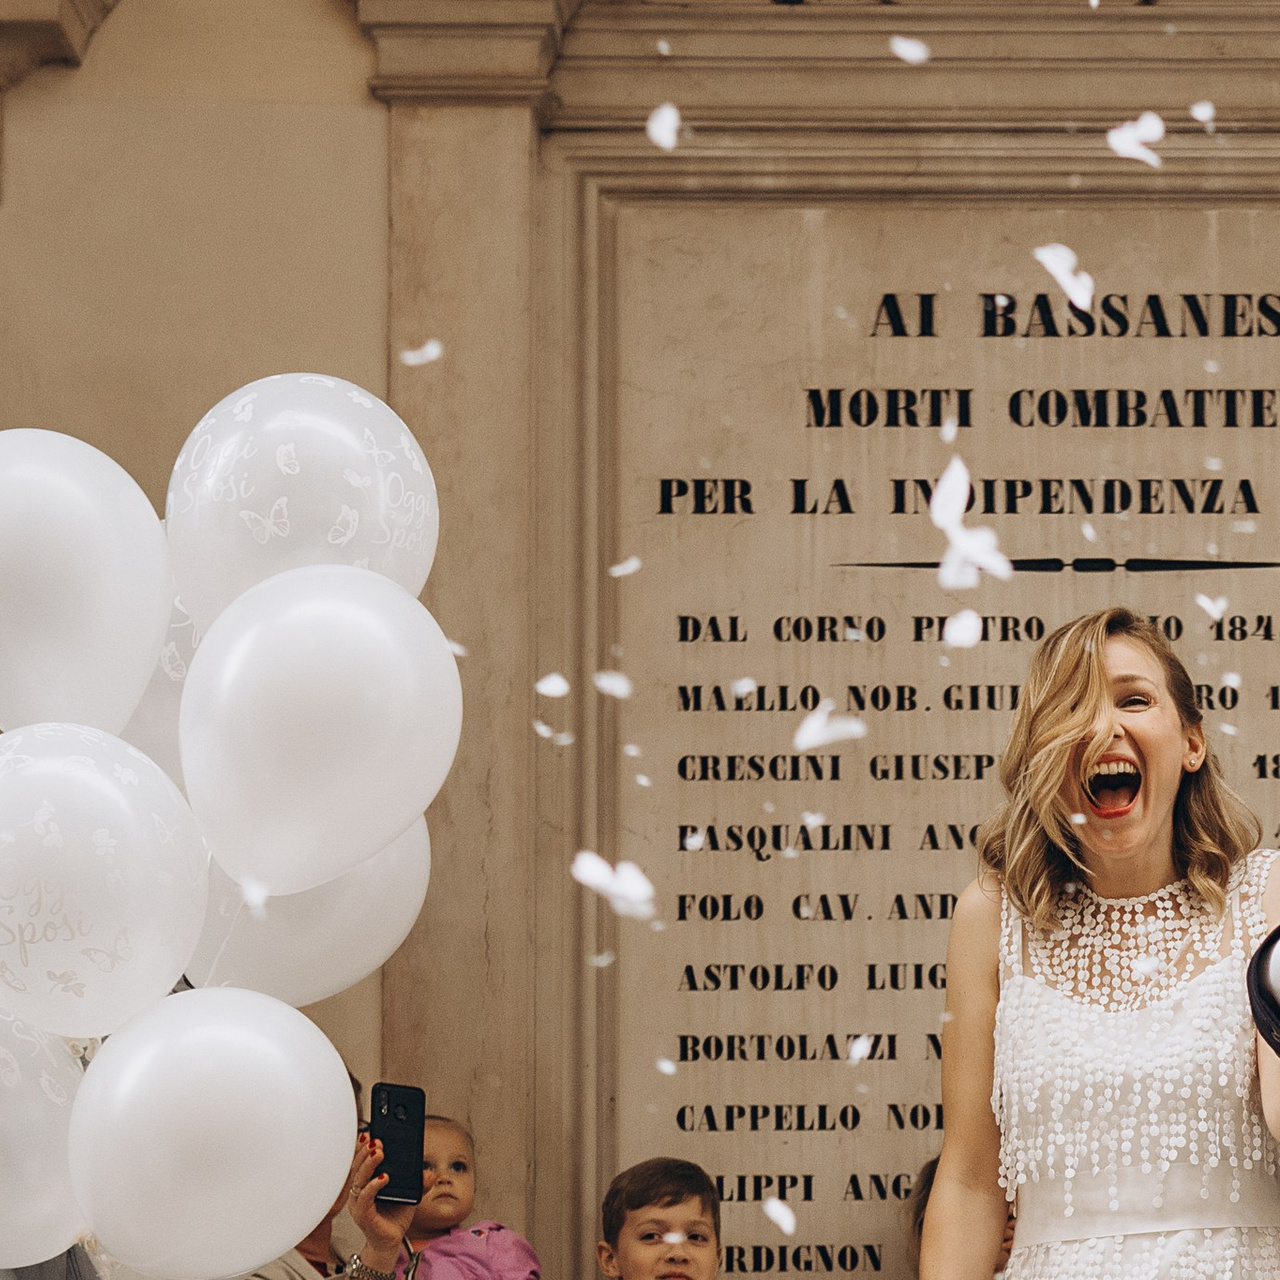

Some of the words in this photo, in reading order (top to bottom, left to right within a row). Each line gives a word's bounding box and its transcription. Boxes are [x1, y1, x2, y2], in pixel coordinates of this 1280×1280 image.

[869, 292, 938, 338] AI
[805, 388, 974, 428] MORTI
[656, 478, 755, 515] PER
[790, 478, 855, 515] LA
[677, 615, 748, 643] DAL
[773, 615, 887, 643] CORNO
[913, 615, 1046, 643] PITRO
[1194, 684, 1239, 711] RO
[677, 754, 841, 782] CRESCINI
[869, 754, 997, 781] GIUSEP
[677, 824, 893, 862] PASQUALINI
[677, 894, 765, 921] FOLO
[792, 894, 873, 921] CAV.
[887, 893, 959, 920] AND
[677, 964, 839, 991] ASTOLFO
[866, 963, 947, 990] LUIG
[676, 1104, 861, 1132] CAPPELLO
[715, 1174, 815, 1202] LIPPI
[843, 1173, 913, 1201] ANG
[724, 1243, 885, 1274] RDIGNON
